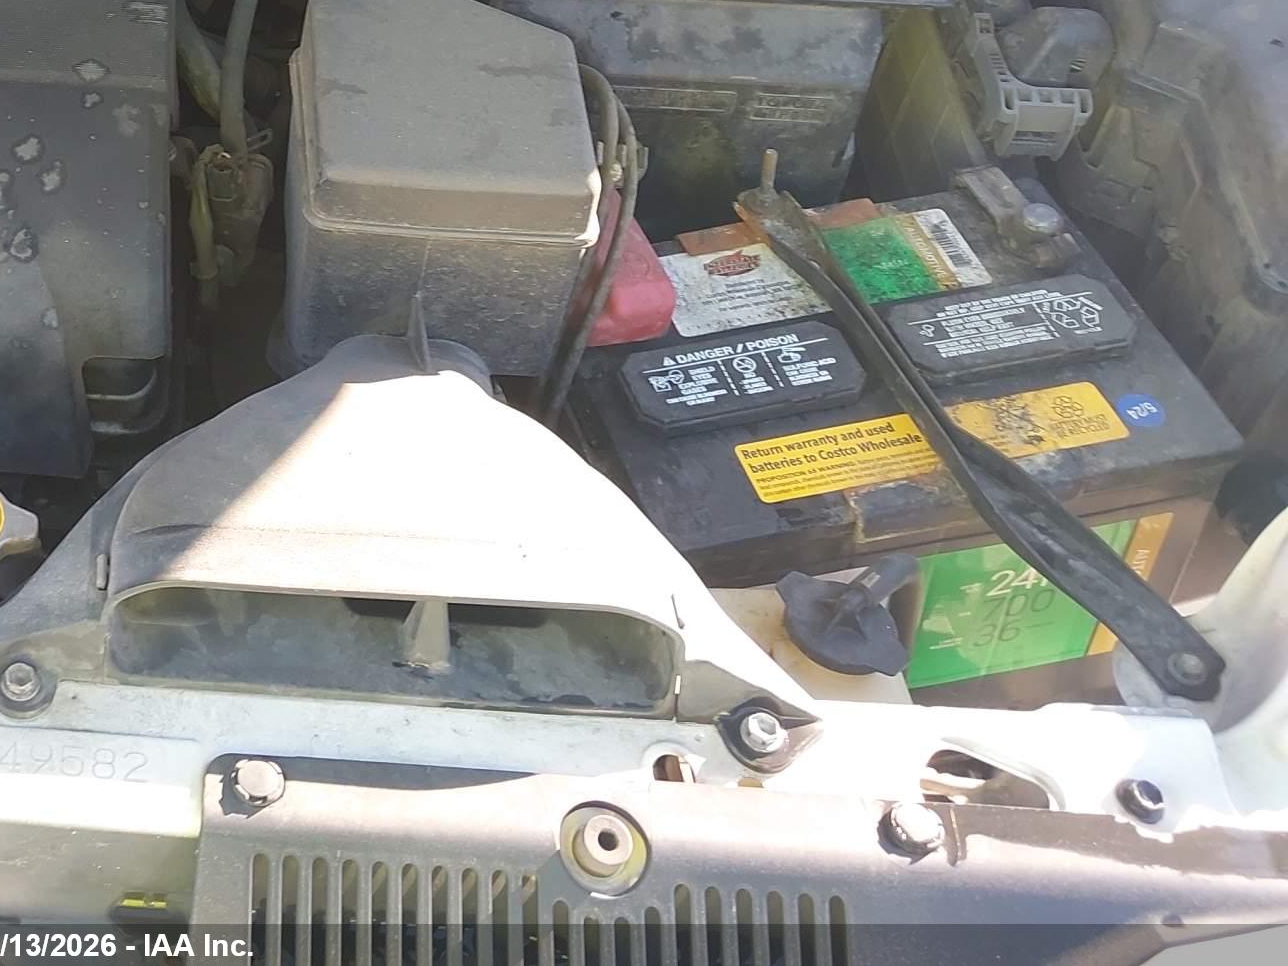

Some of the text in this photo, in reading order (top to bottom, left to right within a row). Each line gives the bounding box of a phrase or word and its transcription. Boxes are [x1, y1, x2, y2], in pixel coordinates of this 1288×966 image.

[675, 346, 734, 364] DANGER
[745, 333, 800, 351] POISON
[741, 422, 895, 461] Return warranty and used
[749, 455, 803, 474] batteries
[803, 453, 818, 465] to
[819, 446, 858, 462] Costco
[857, 433, 923, 455] Wholesale
[983, 588, 1055, 622] 700
[972, 618, 1021, 648] 36
